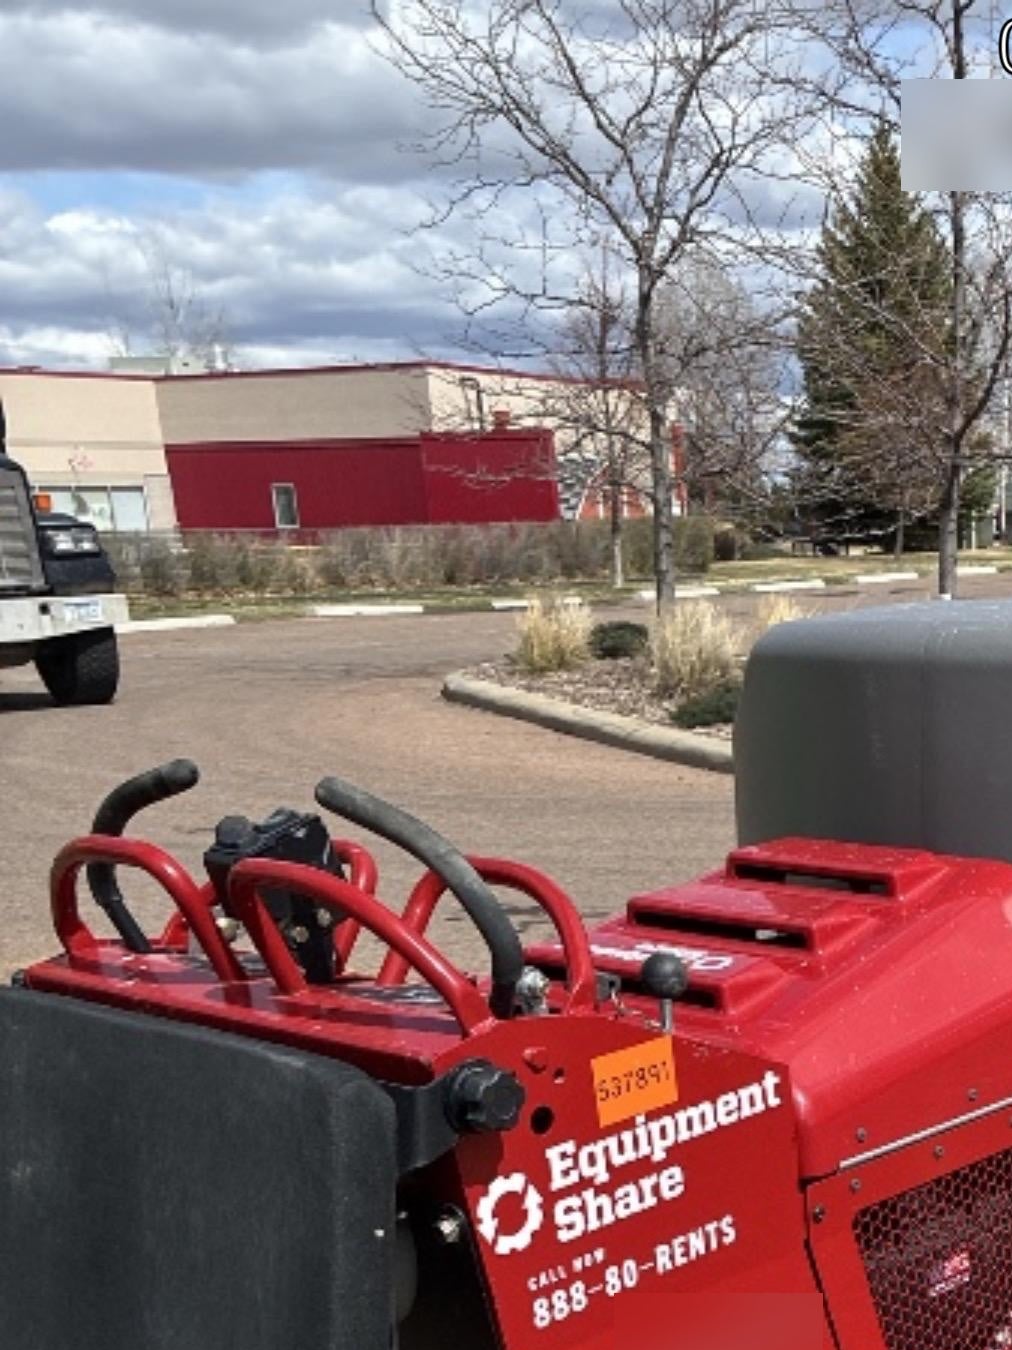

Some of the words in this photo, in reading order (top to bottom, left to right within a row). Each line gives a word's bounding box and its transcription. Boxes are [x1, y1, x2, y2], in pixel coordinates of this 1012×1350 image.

[545, 1070, 782, 1192] Equipment
[553, 1165, 685, 1243] Share
[527, 1265, 568, 1292] CALL
[532, 1213, 737, 1330] 888-80-RENTS
